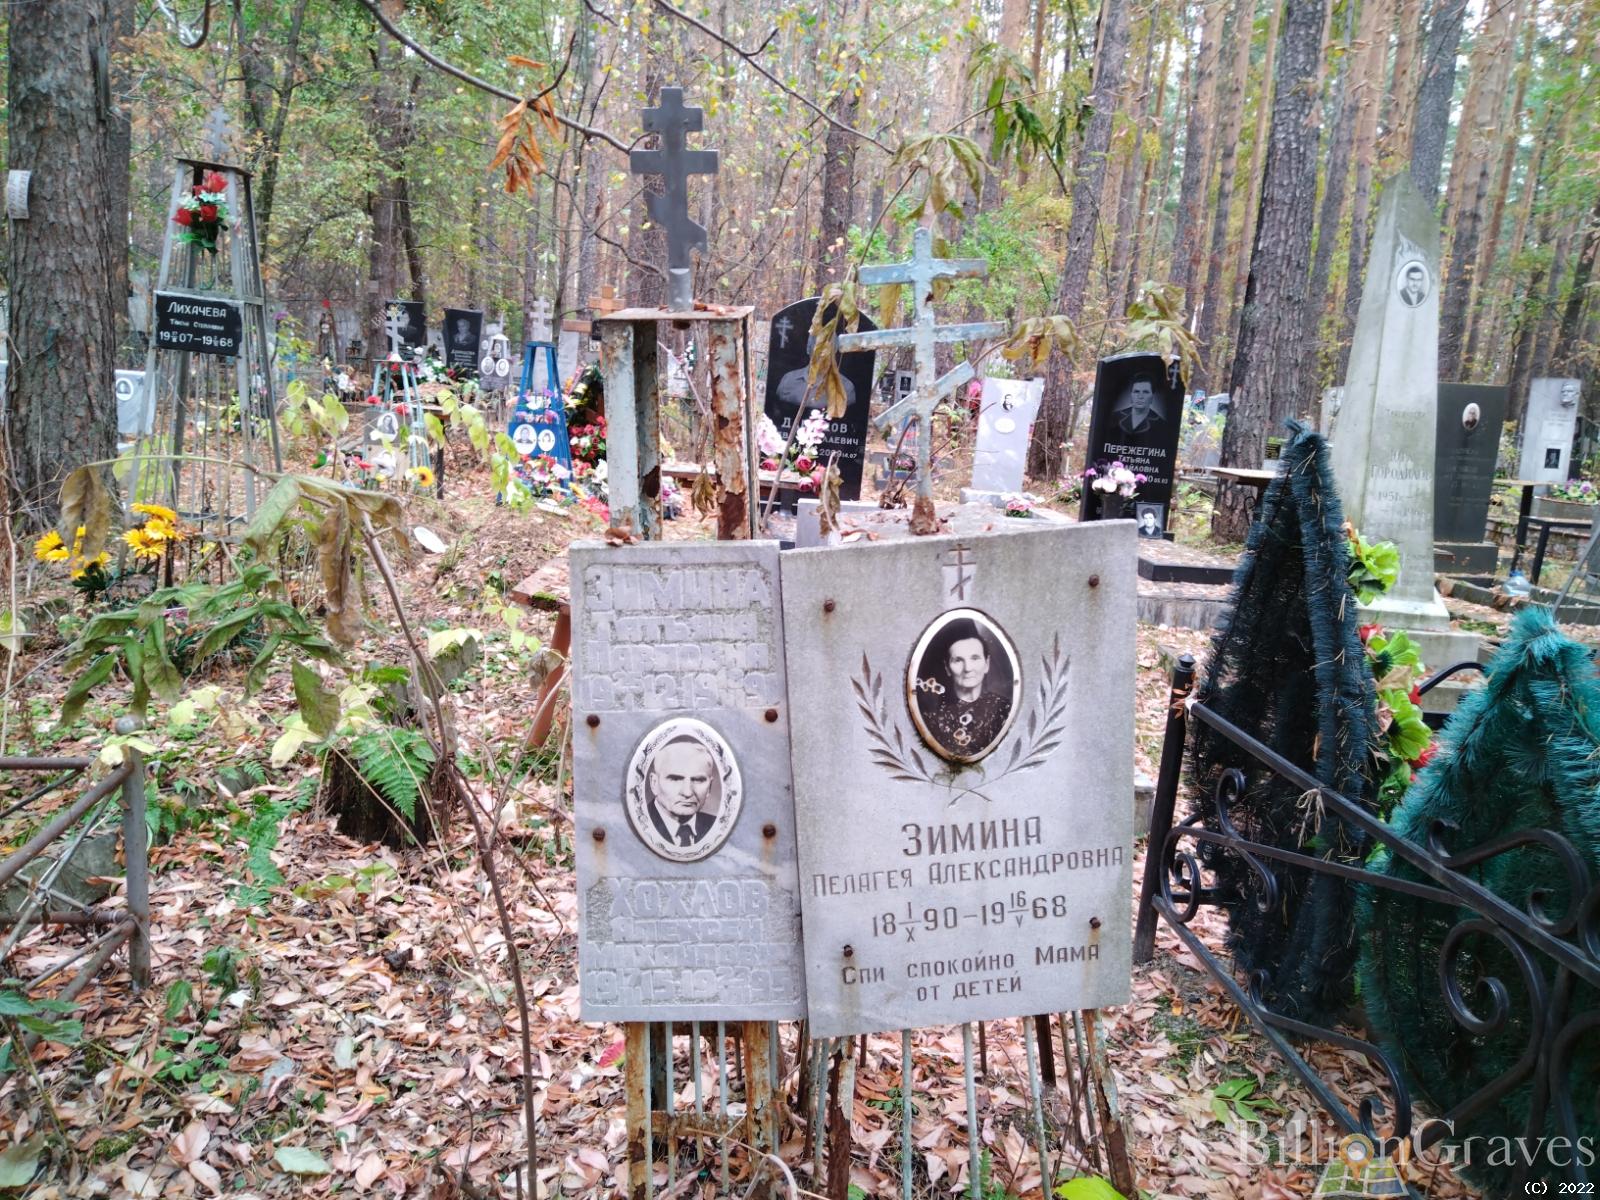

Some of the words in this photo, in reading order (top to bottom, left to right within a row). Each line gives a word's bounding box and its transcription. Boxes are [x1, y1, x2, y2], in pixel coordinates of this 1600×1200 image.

[167, 302, 227, 318] ЛИХАЧЕВА
[1103, 443, 1166, 458] ПЕРЕЖЕГИНА
[902, 816, 1042, 856] ЗИМИНА
[812, 868, 912, 897] ПЕЛАГЕЯ
[928, 846, 1124, 885] АЛЕКСАНДРОВНА
[609, 878, 769, 917] ХОХЛОВ
